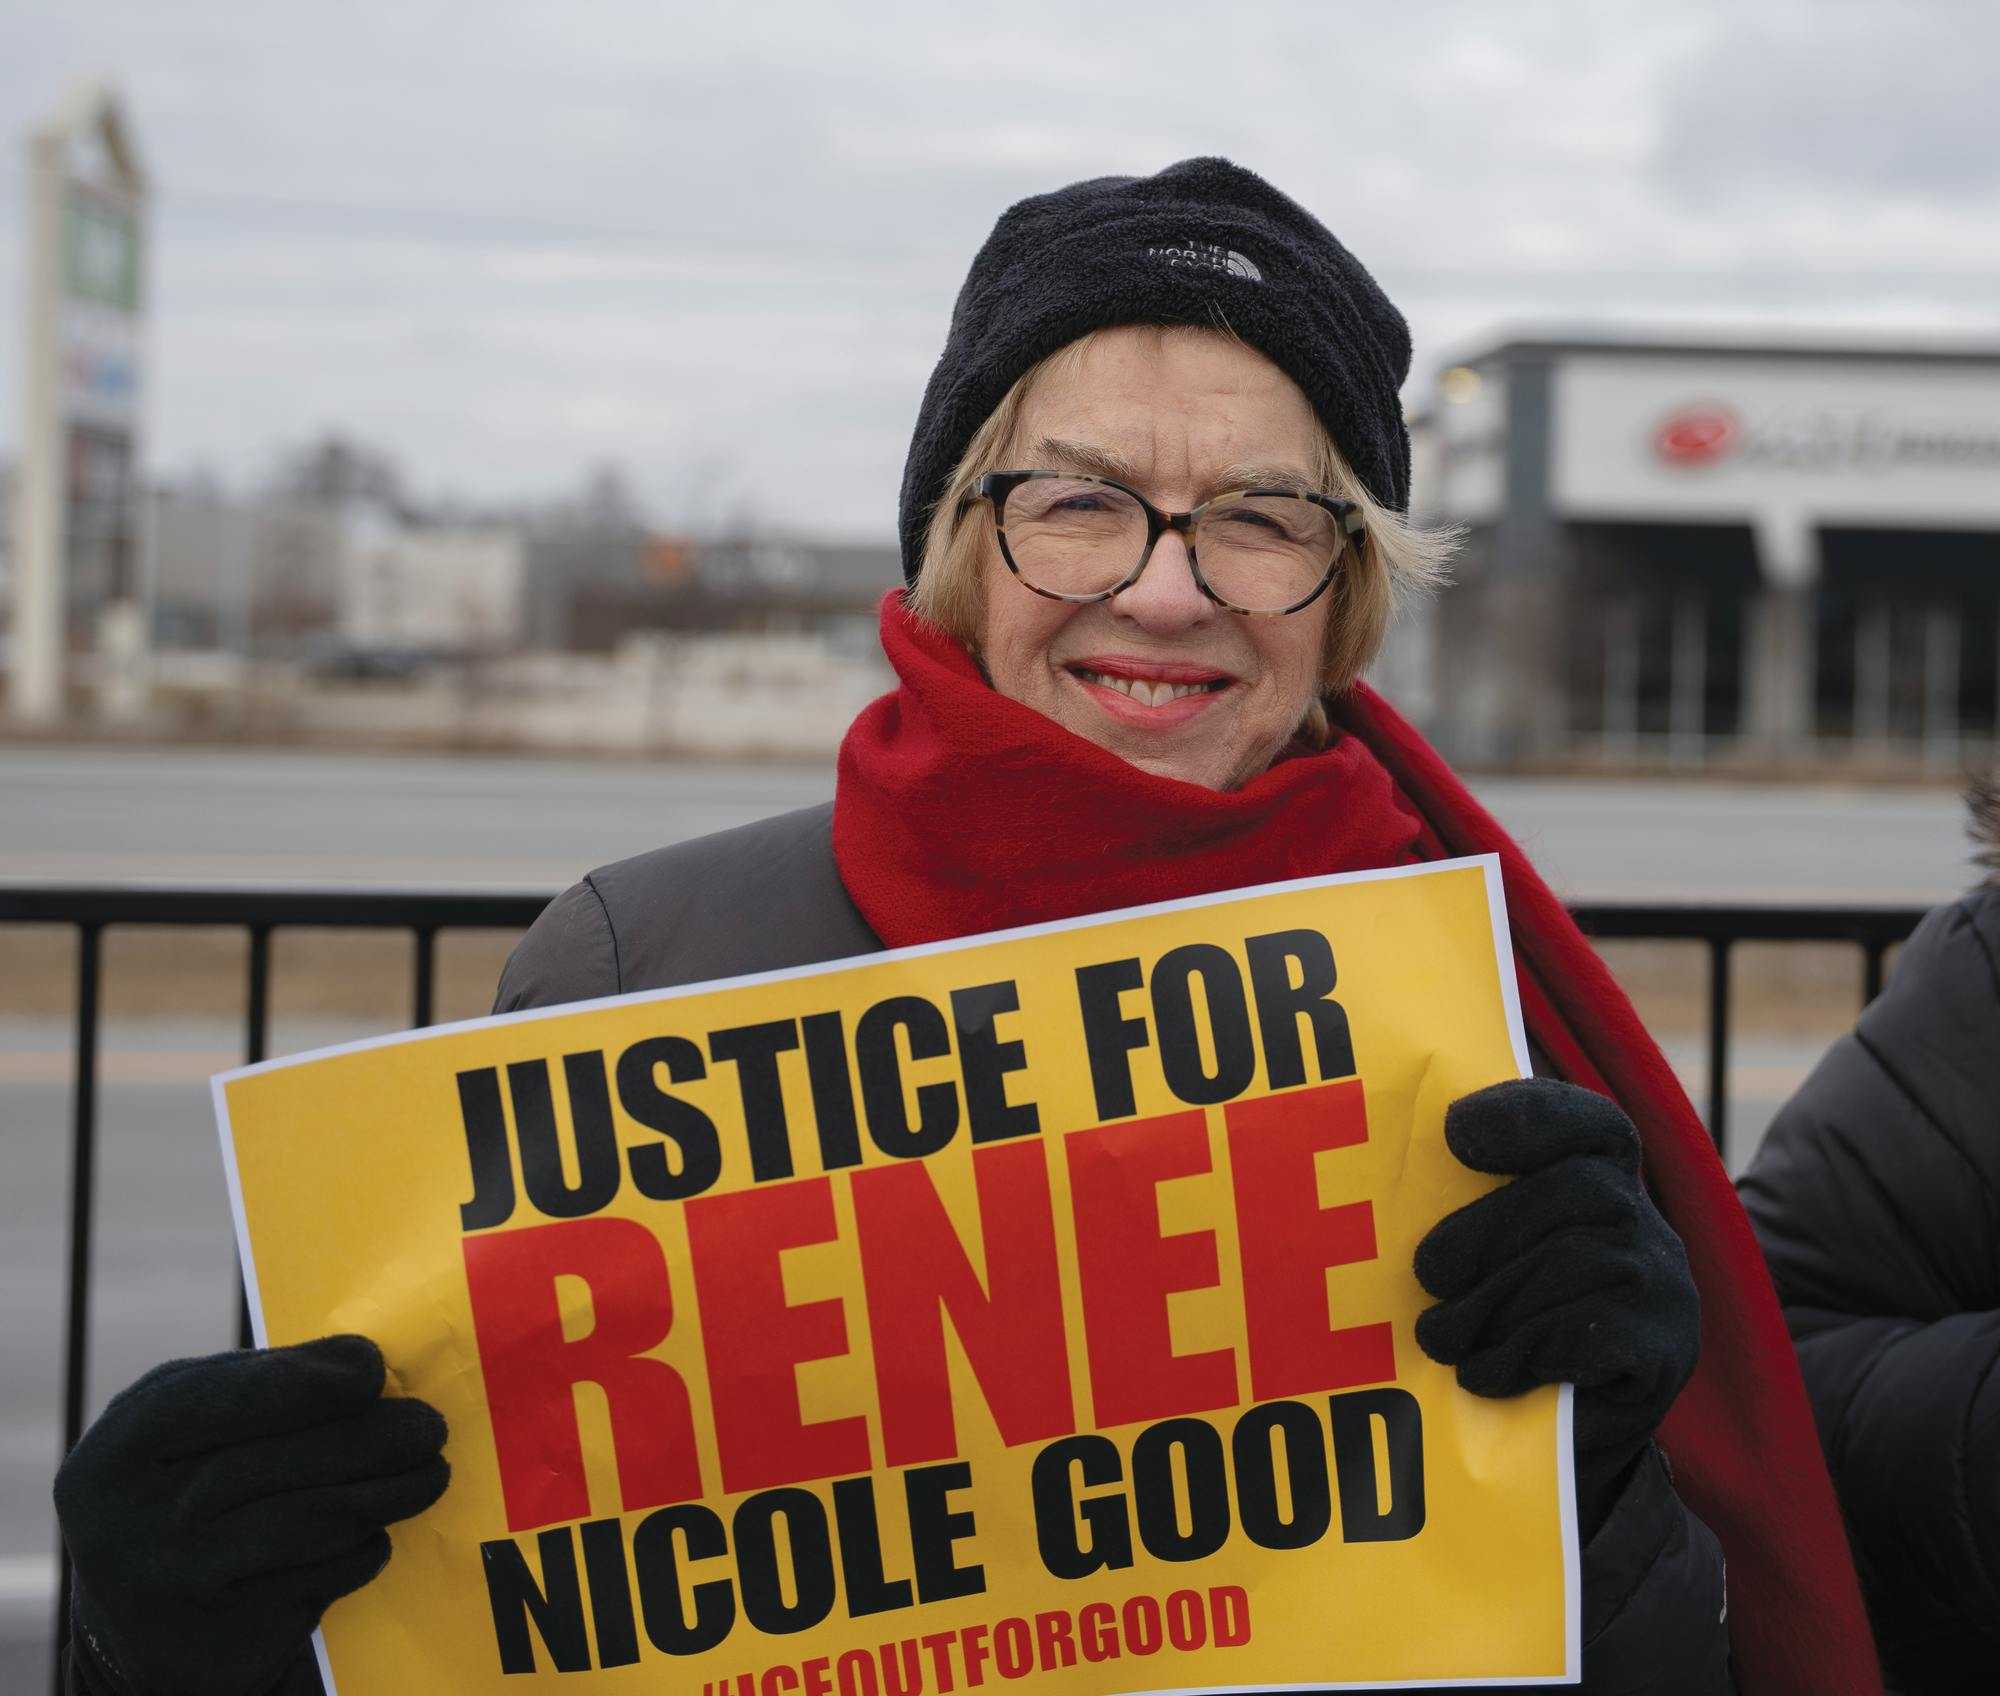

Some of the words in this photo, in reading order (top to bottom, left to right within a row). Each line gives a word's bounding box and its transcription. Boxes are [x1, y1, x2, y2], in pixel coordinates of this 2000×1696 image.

[456, 980, 1041, 1231] JUSTICE
[1075, 928, 1356, 1121] FOR
[462, 1079, 1397, 1532] RENEE
[480, 1461, 987, 1675] NICOLE
[1031, 1387, 1426, 1580] GOOD
[703, 1586, 1251, 1696] CEOUTFORGOOD
